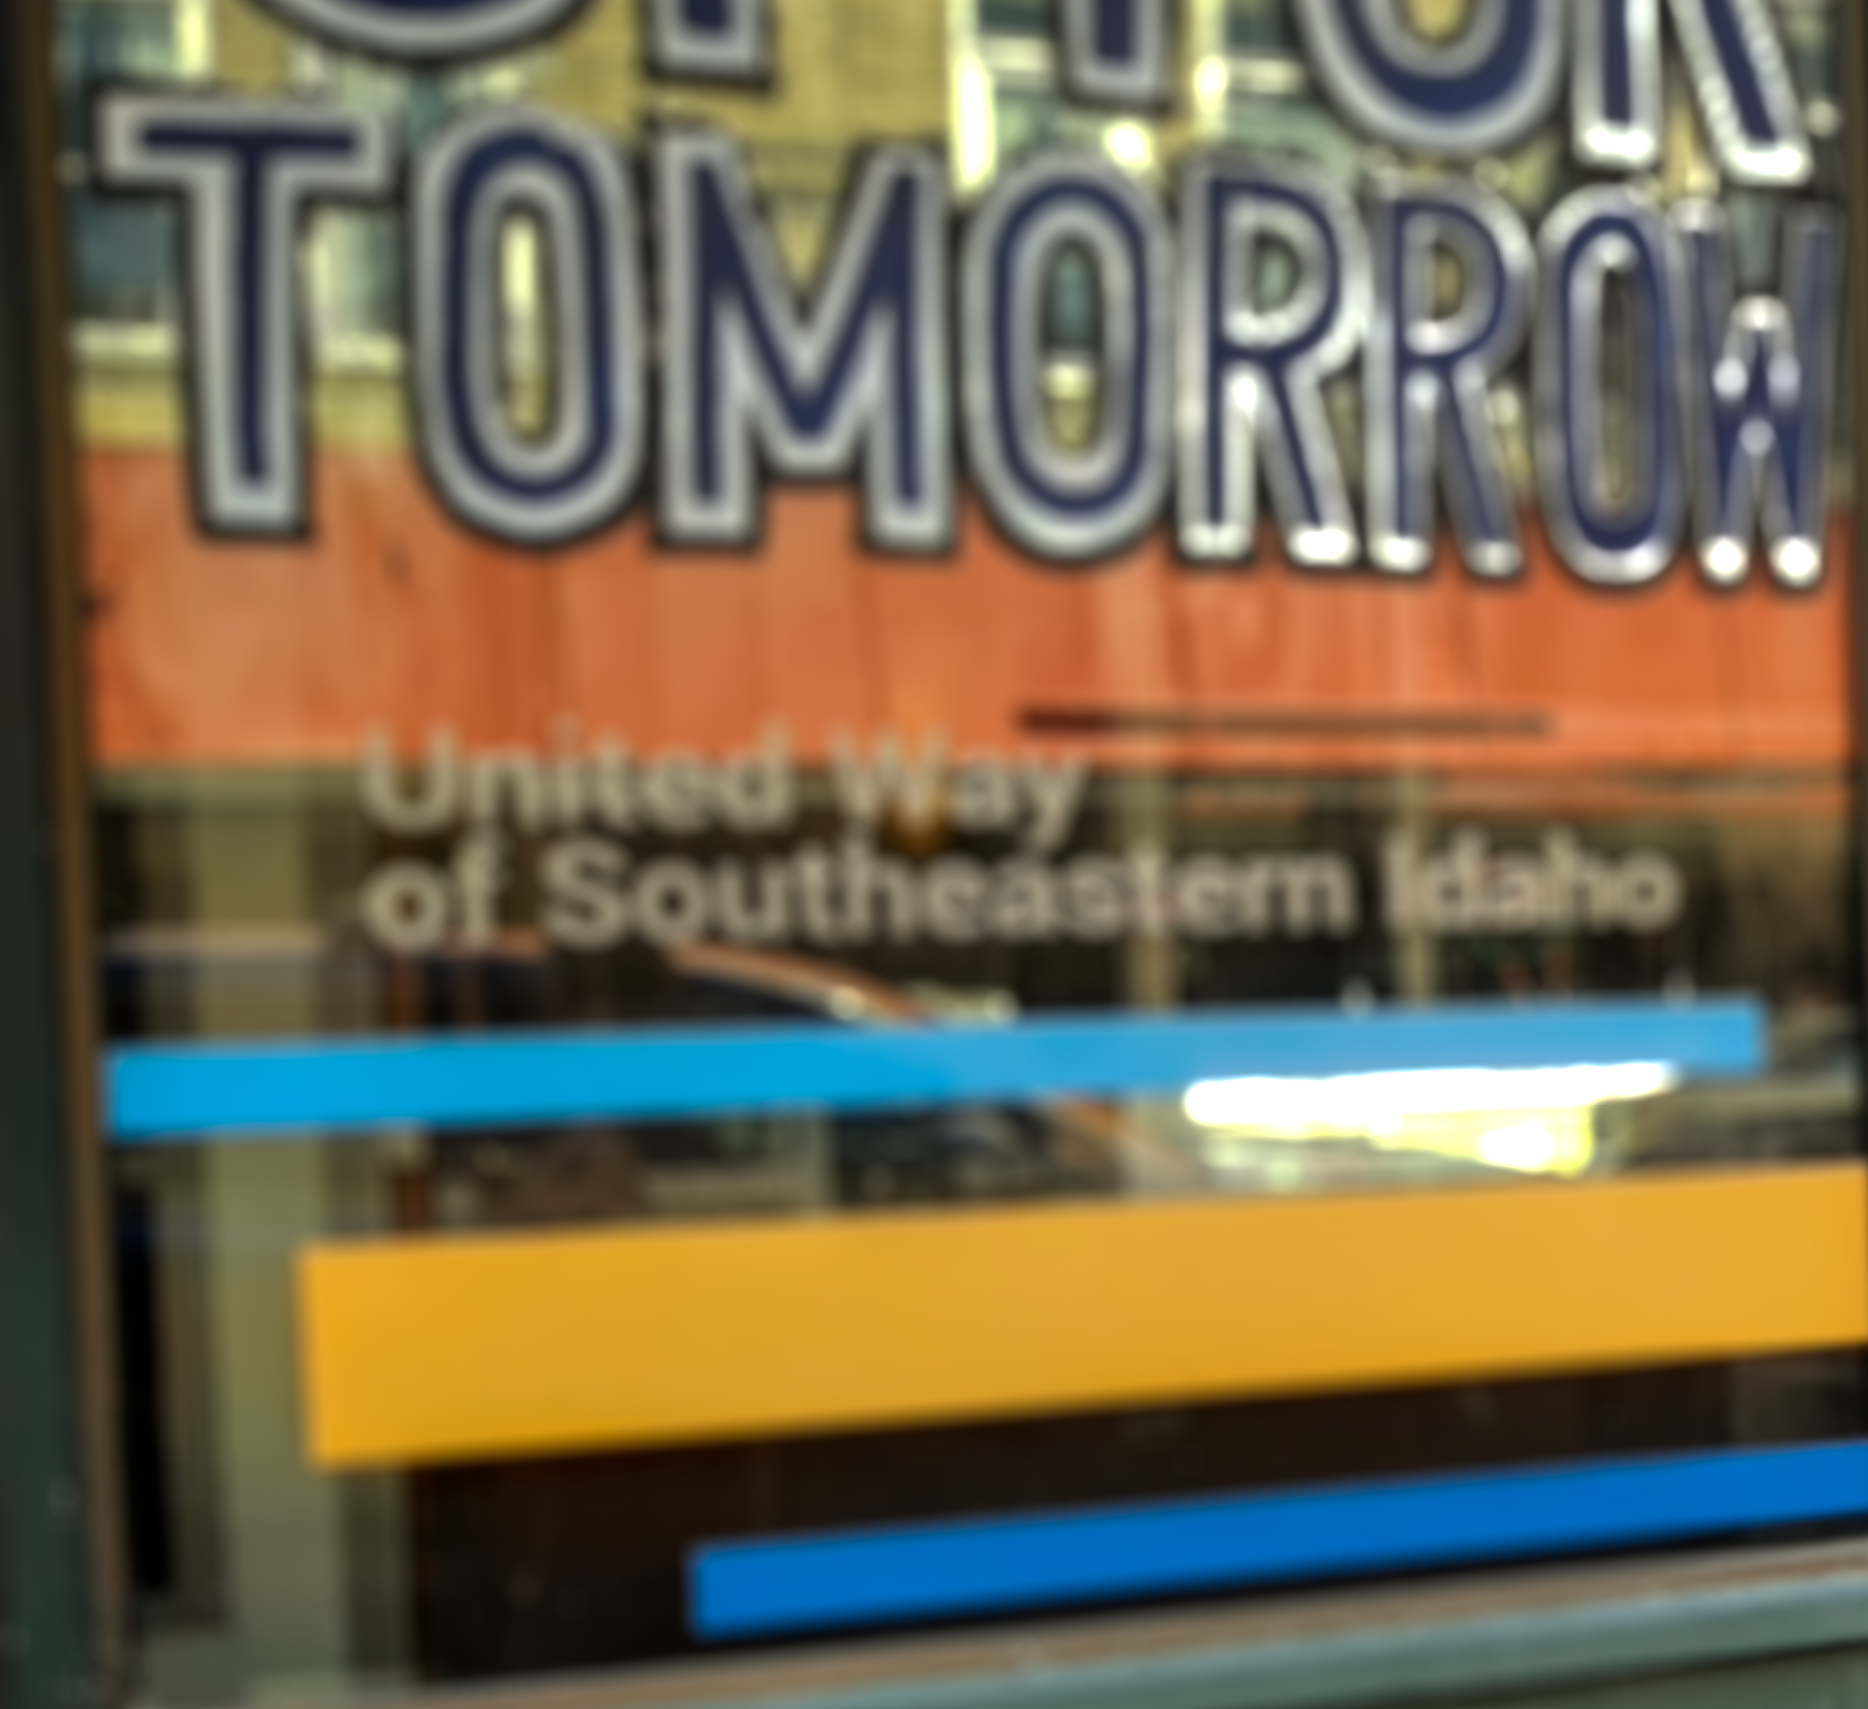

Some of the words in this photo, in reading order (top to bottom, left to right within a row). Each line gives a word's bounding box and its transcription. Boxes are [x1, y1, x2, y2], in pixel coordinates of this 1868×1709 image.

[100, 88, 1845, 586] TOMORROW
[362, 712, 800, 835] United
[824, 722, 1088, 858] Way
[362, 826, 512, 953] of
[540, 822, 1358, 952] Southeastern
[1382, 822, 1687, 937] Idaho
